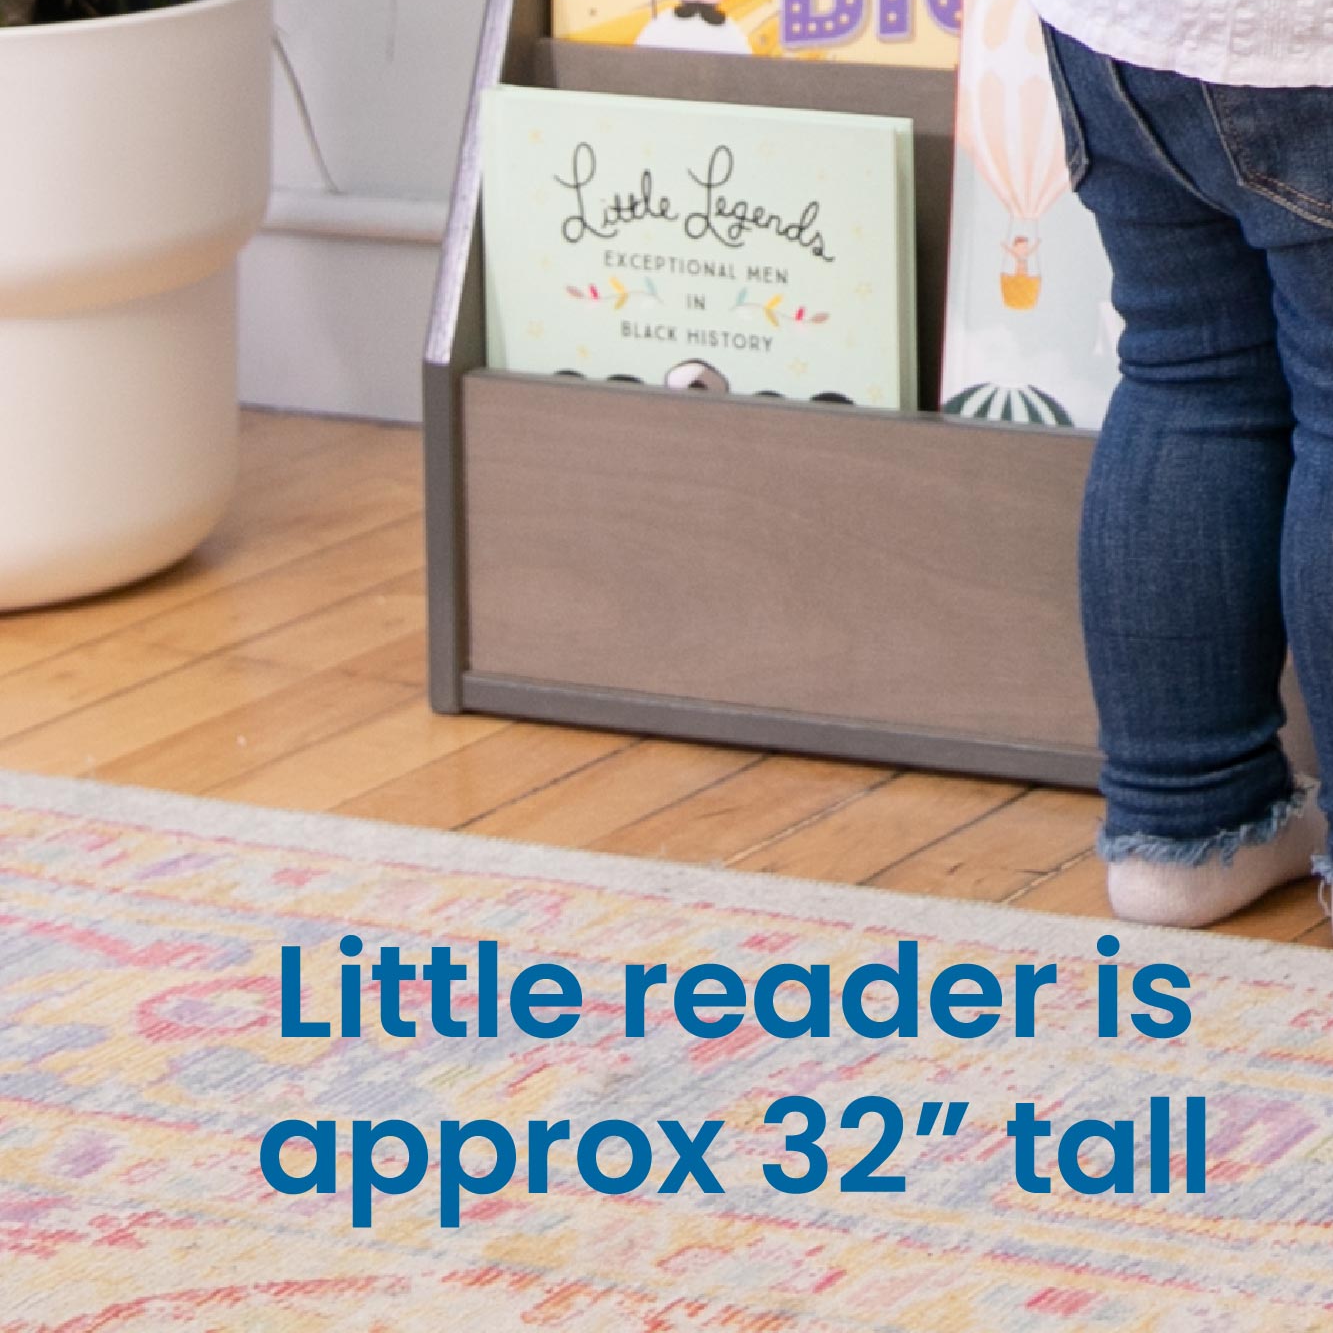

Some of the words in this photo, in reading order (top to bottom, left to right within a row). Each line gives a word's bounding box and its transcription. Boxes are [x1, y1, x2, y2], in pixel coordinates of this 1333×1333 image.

[554, 142, 678, 243] Little
[684, 145, 835, 262] Legends
[604, 249, 737, 281] EXCEPTIONAL
[747, 267, 790, 284] MEN
[686, 295, 706, 311] IN
[621, 321, 677, 343] BLACK
[686, 328, 774, 353] HISTORY
